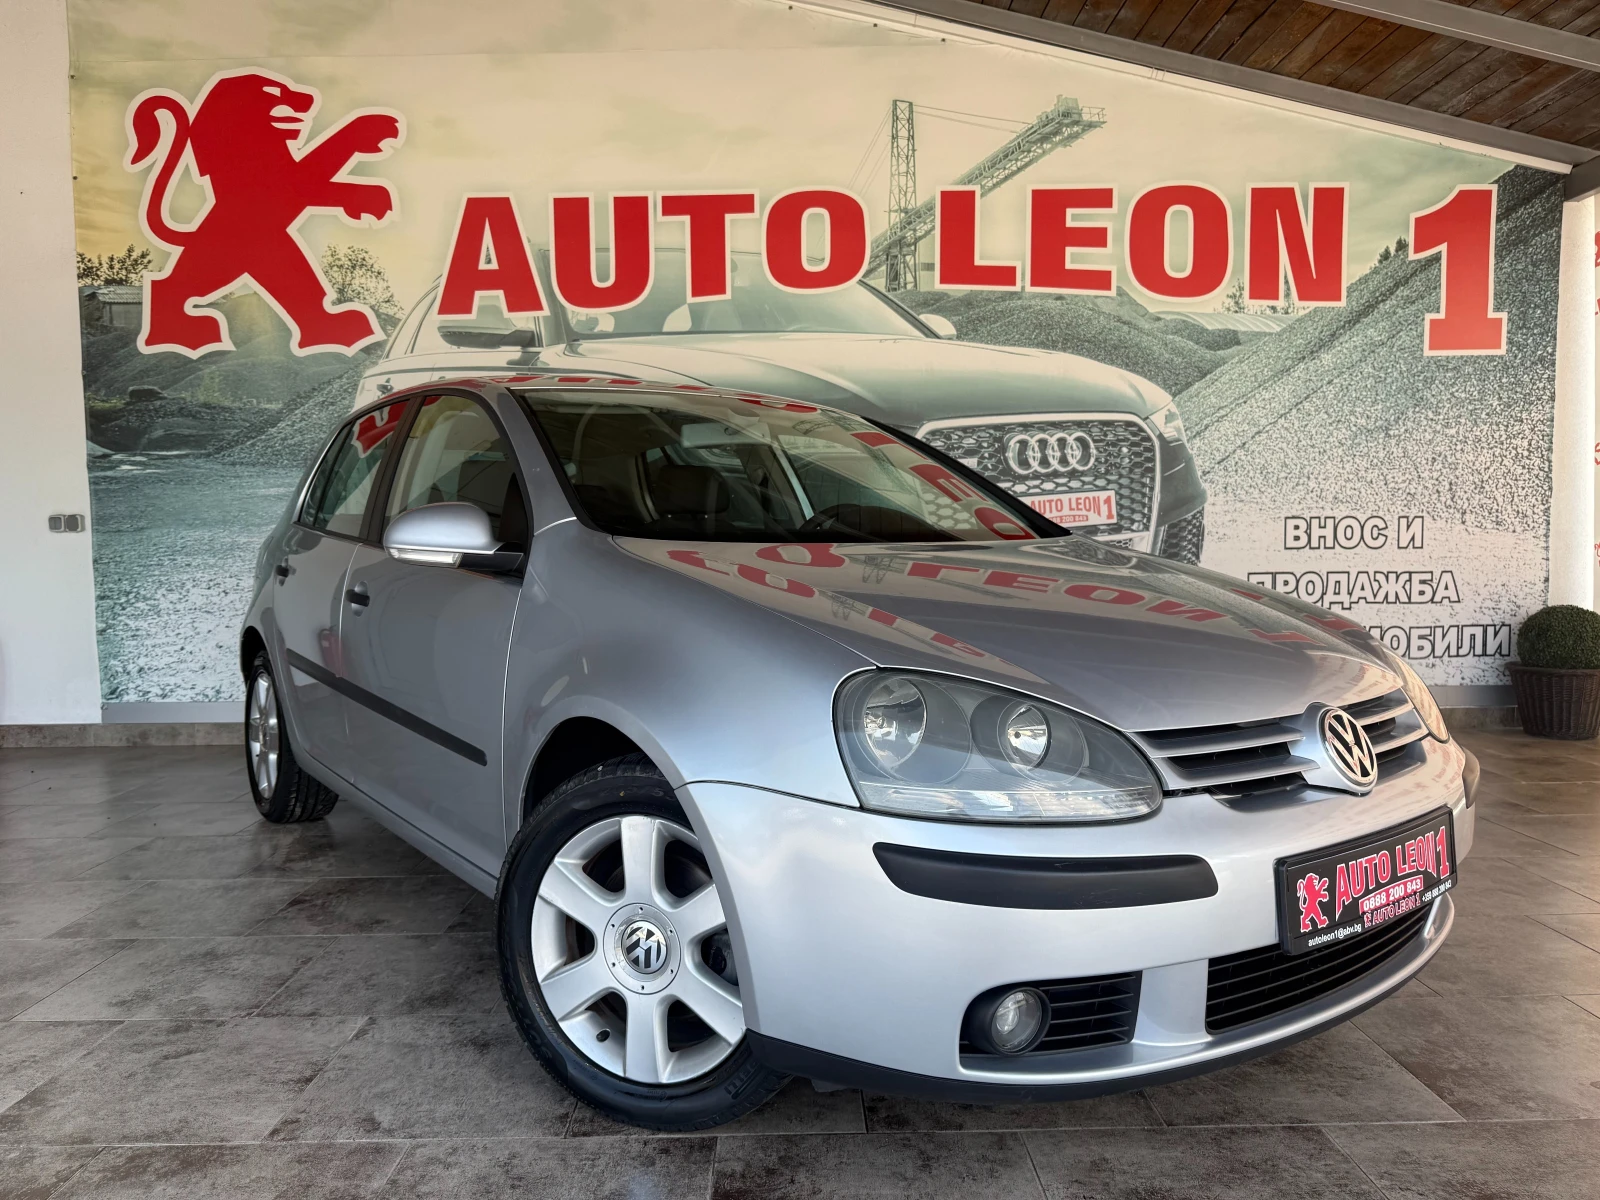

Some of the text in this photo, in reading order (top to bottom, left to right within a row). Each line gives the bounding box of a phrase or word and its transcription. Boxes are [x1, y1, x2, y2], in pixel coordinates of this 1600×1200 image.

[434, 183, 1506, 354] AUTO LEON 1
[1029, 495, 1114, 520] AUTO LEON 1
[1284, 516, 1425, 550] ВНОС И
[1336, 825, 1450, 922] AUTO LEON 1
[1363, 878, 1421, 911] 0888 200 843
[1373, 905, 1394, 926] AUTO
[1395, 896, 1415, 916] LEON
[1308, 923, 1362, 947] autoleon1@abv.bg
